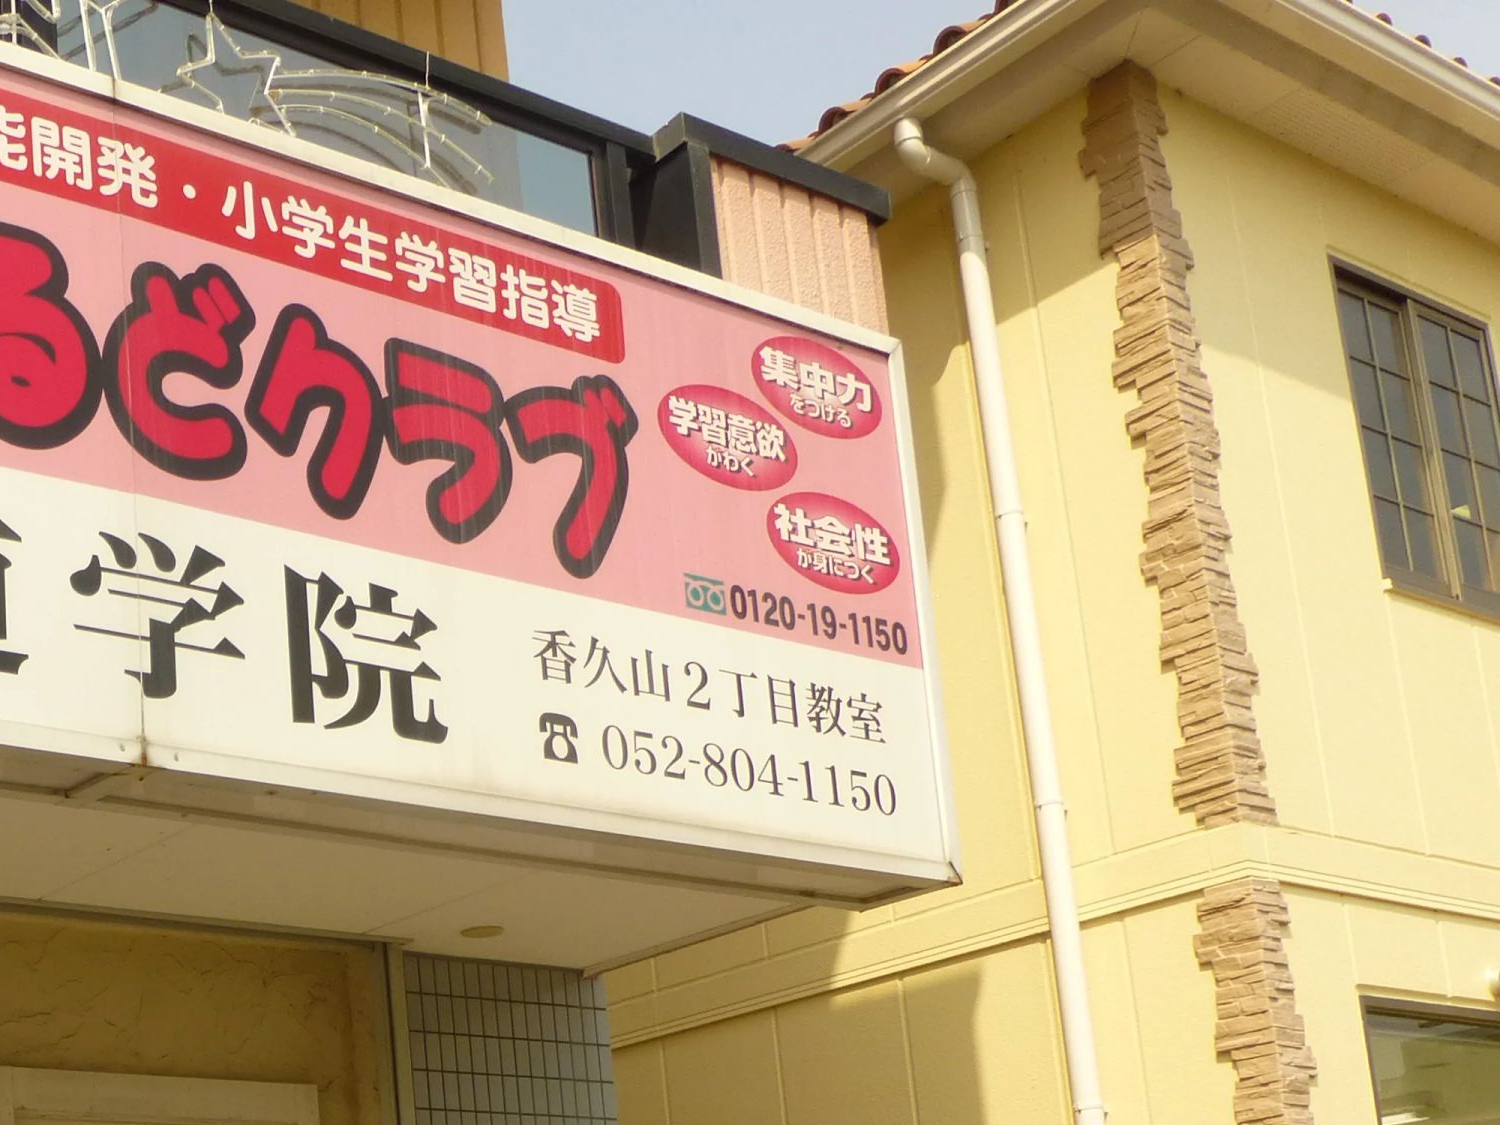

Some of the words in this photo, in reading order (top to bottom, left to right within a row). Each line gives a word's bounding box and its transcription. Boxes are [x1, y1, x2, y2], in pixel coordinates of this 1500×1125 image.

[758, 346, 872, 413] 集中力
[789, 392, 853, 429] をつける
[668, 396, 787, 464] 学習意欲
[705, 445, 756, 478] かわく
[772, 503, 892, 566] 社会性
[796, 546, 876, 585] が身につく
[730, 584, 909, 656] 0120-19-1150
[531, 629, 887, 745] 香久山2丁目教室
[601, 724, 897, 817] 052-804-1150
